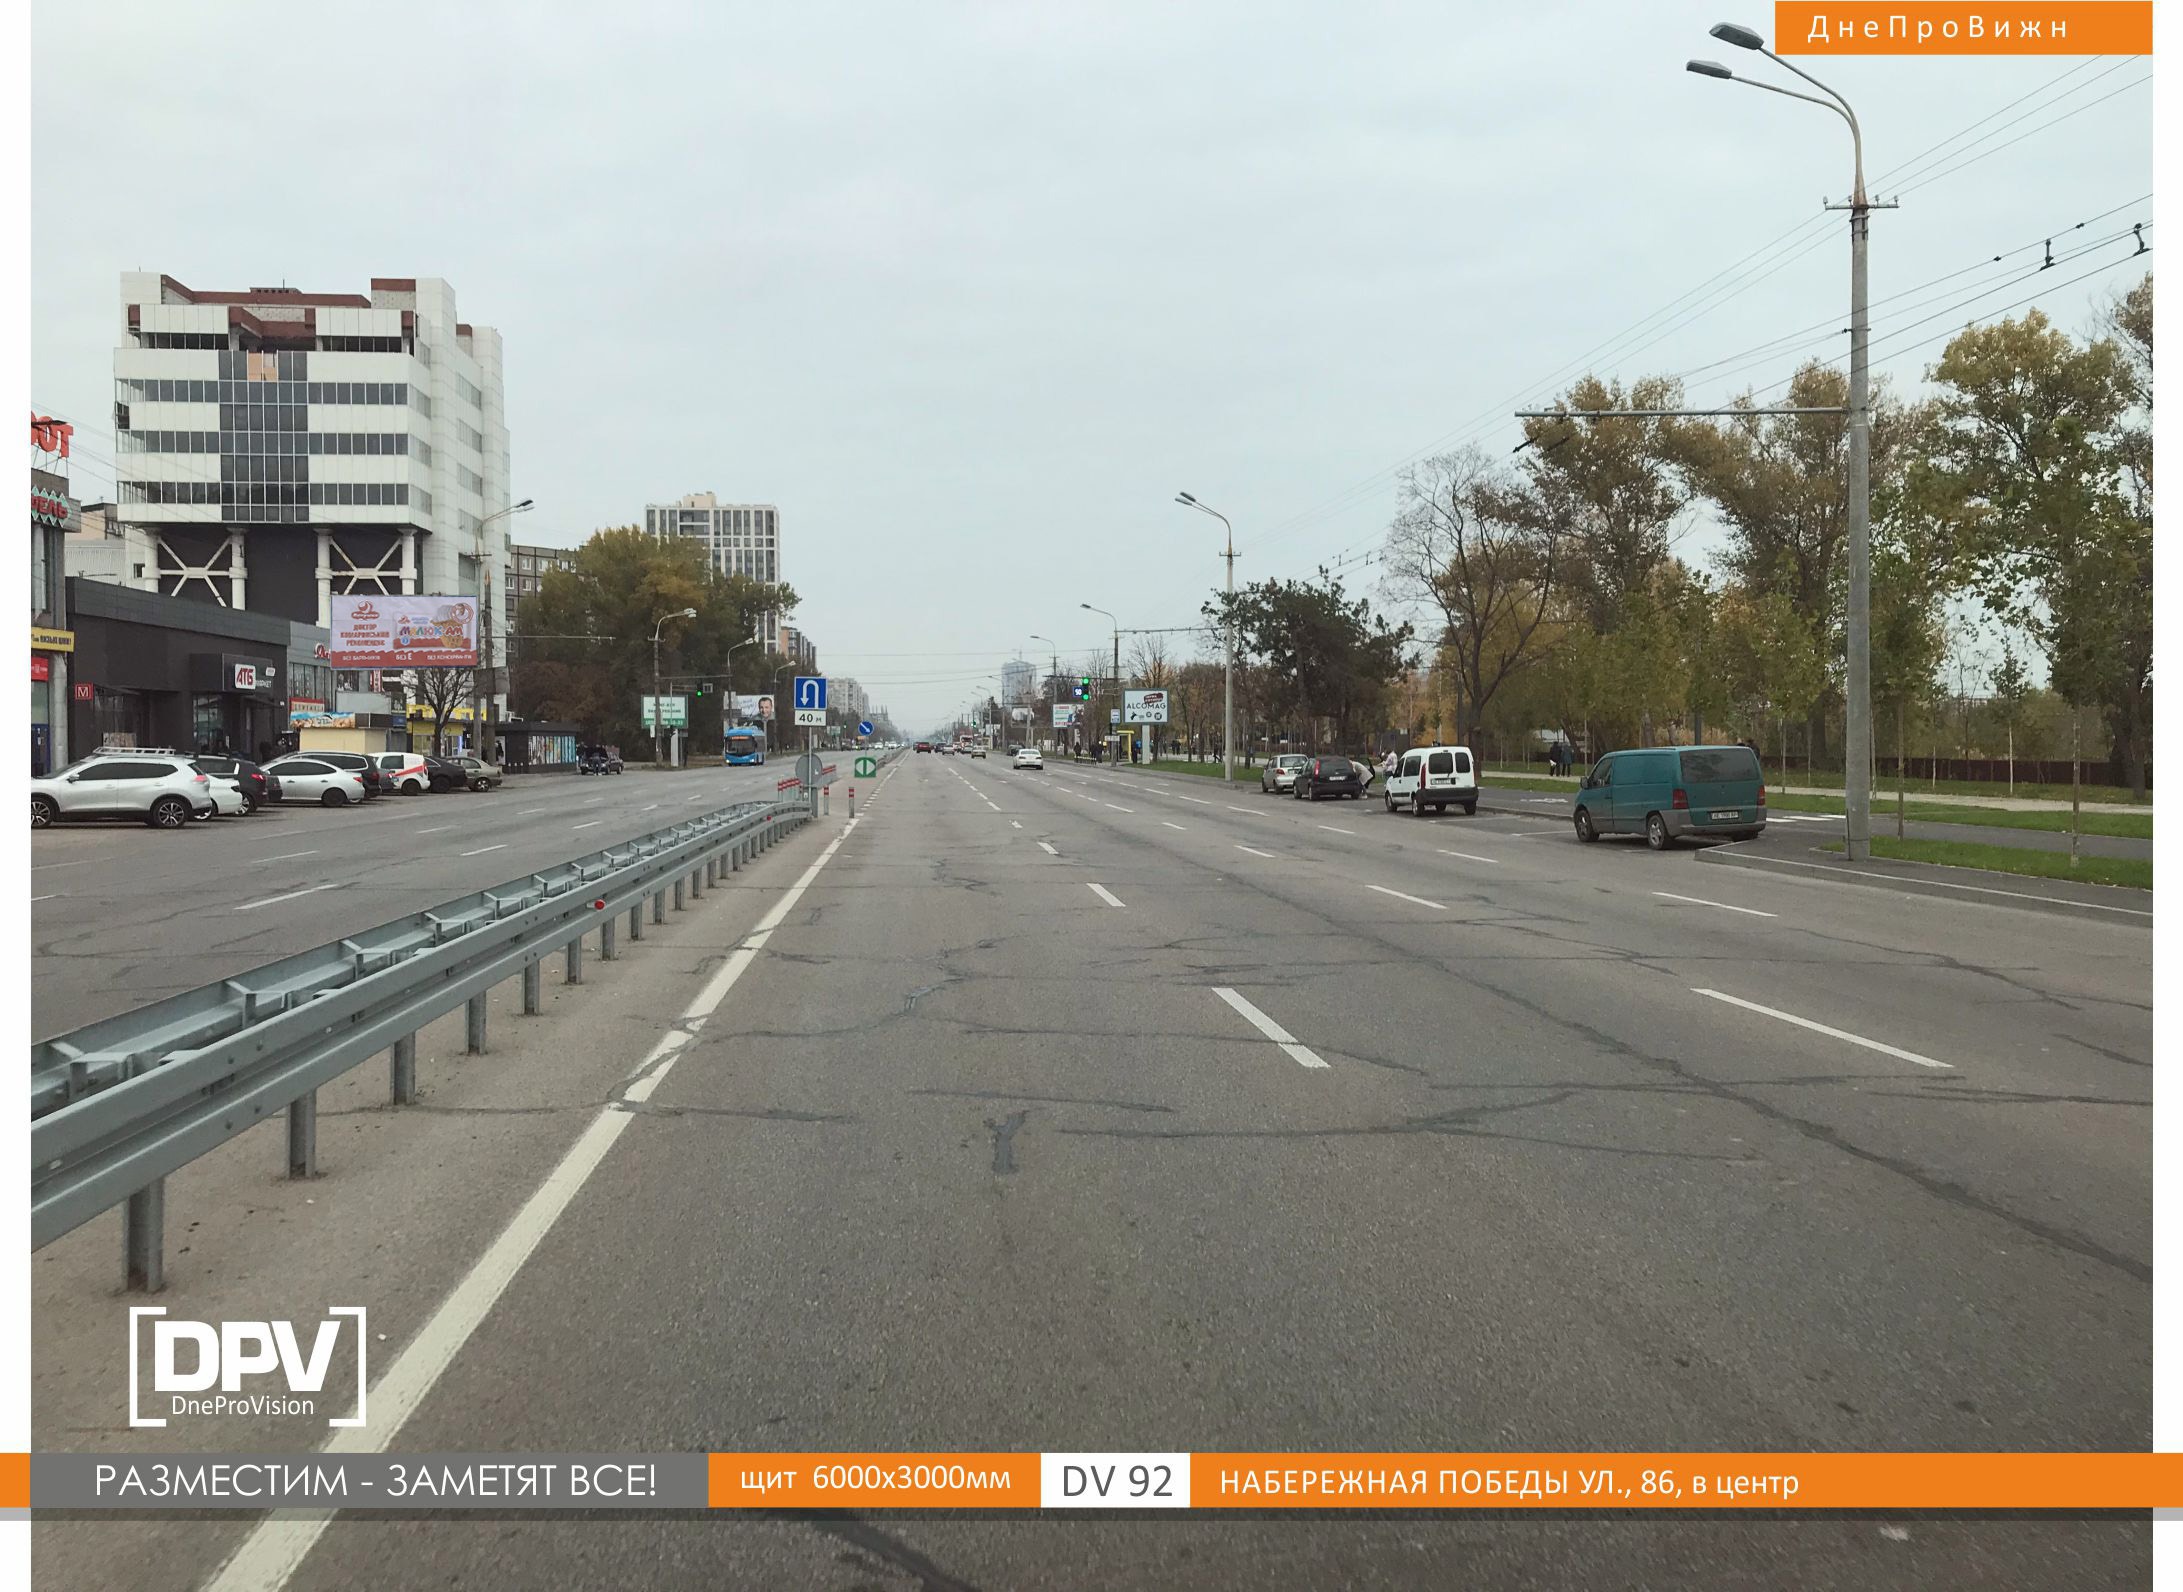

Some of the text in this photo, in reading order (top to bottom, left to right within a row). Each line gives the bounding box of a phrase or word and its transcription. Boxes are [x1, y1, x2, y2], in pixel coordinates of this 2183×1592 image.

[236, 667, 255, 687] АТБ
[1126, 702, 1167, 710] ALCOMAG
[798, 713, 814, 723] 40
